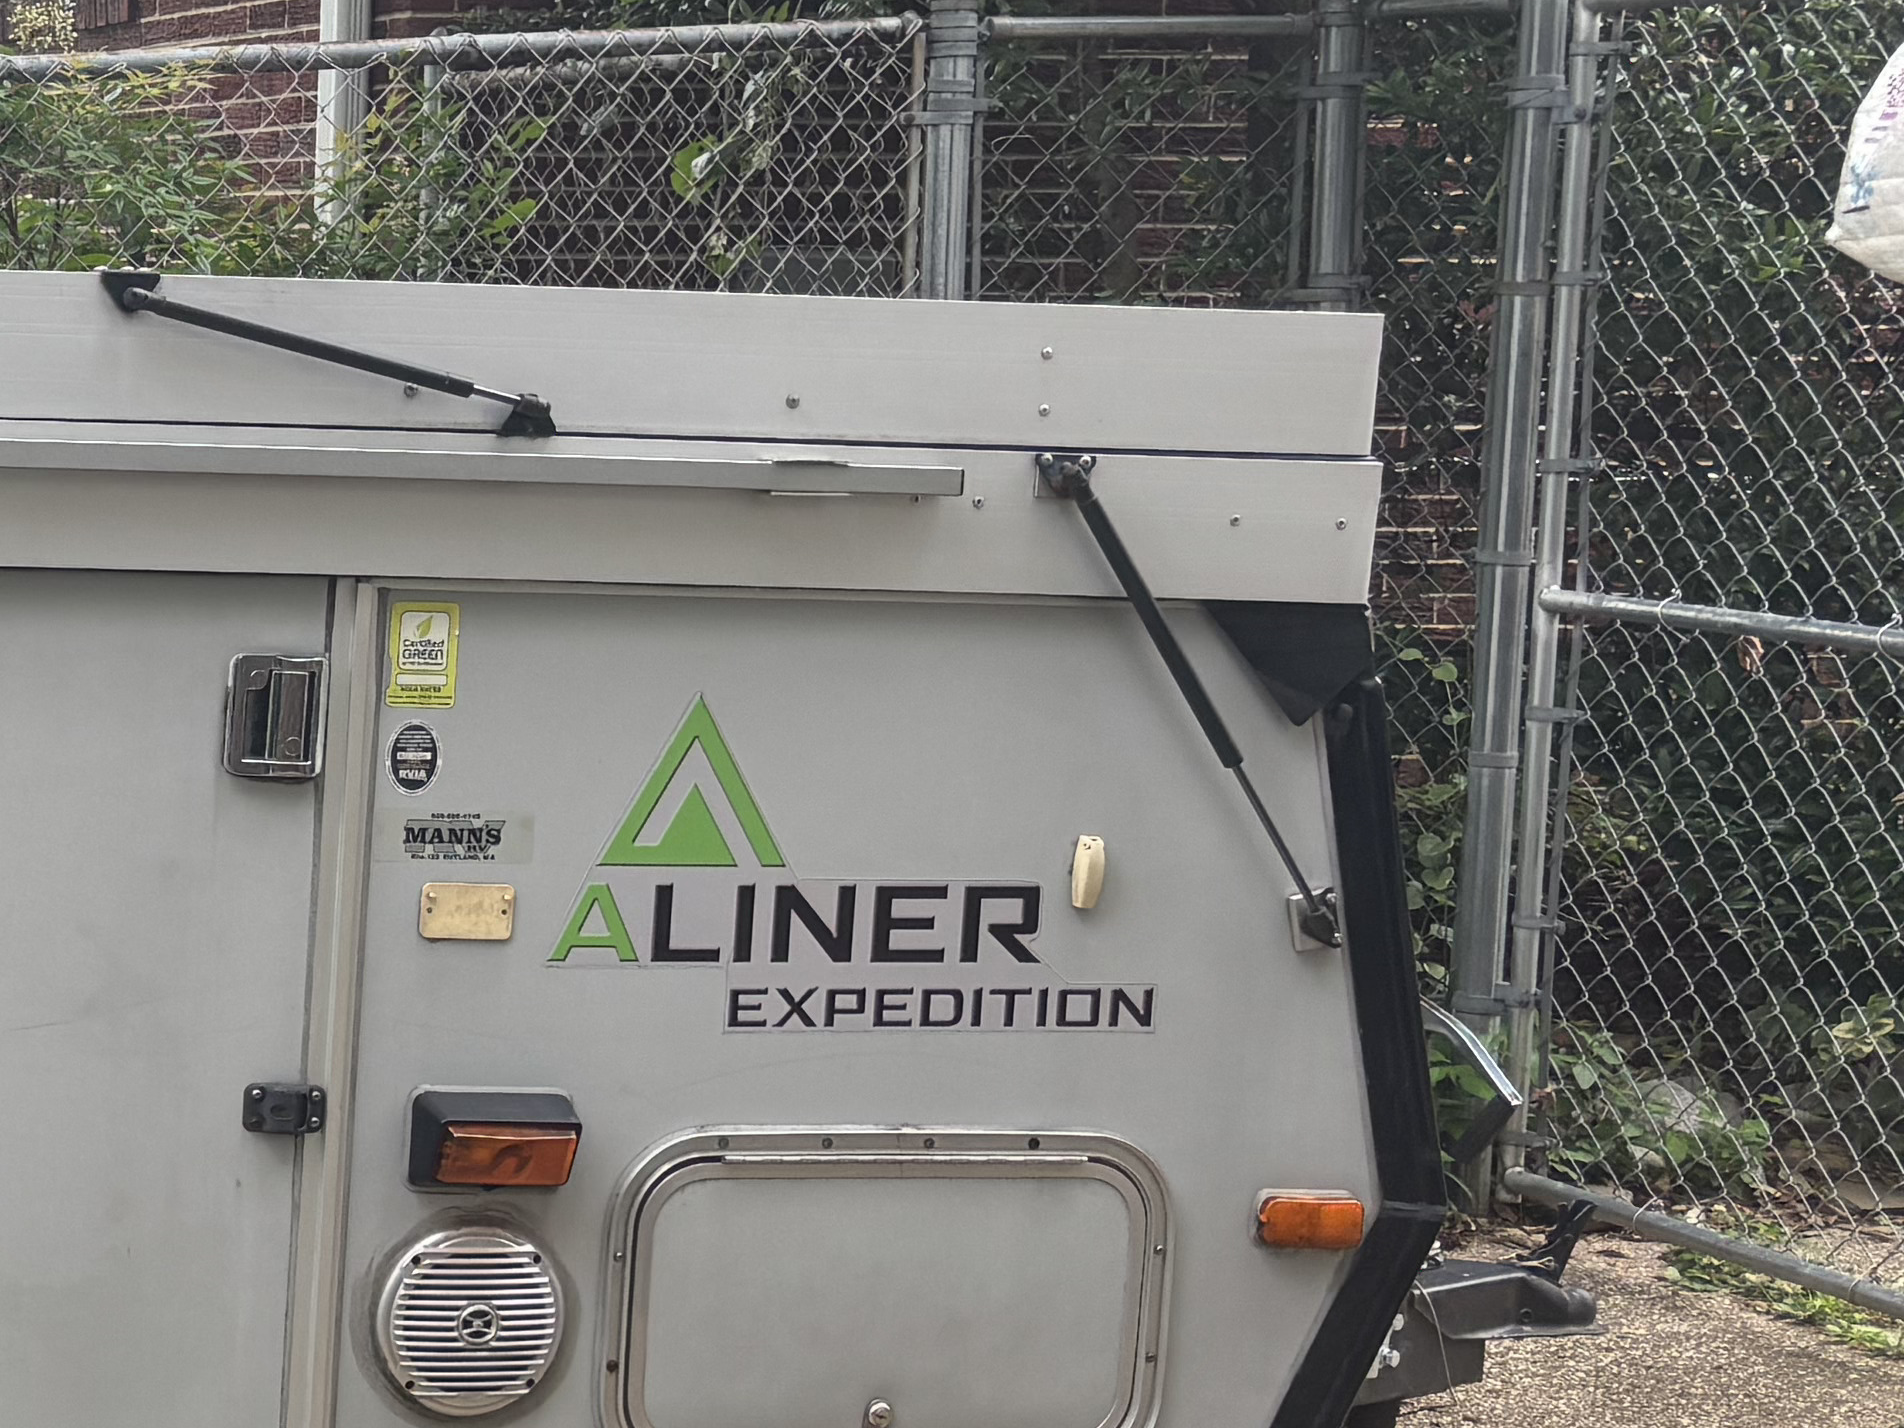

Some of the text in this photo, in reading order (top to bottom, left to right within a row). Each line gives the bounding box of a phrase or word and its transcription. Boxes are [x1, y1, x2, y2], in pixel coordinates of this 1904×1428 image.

[402, 649, 443, 660] GREEN
[403, 824, 501, 845] MANN'S
[547, 882, 1041, 964] ALINER
[727, 986, 1154, 1029] EXPEDITION
